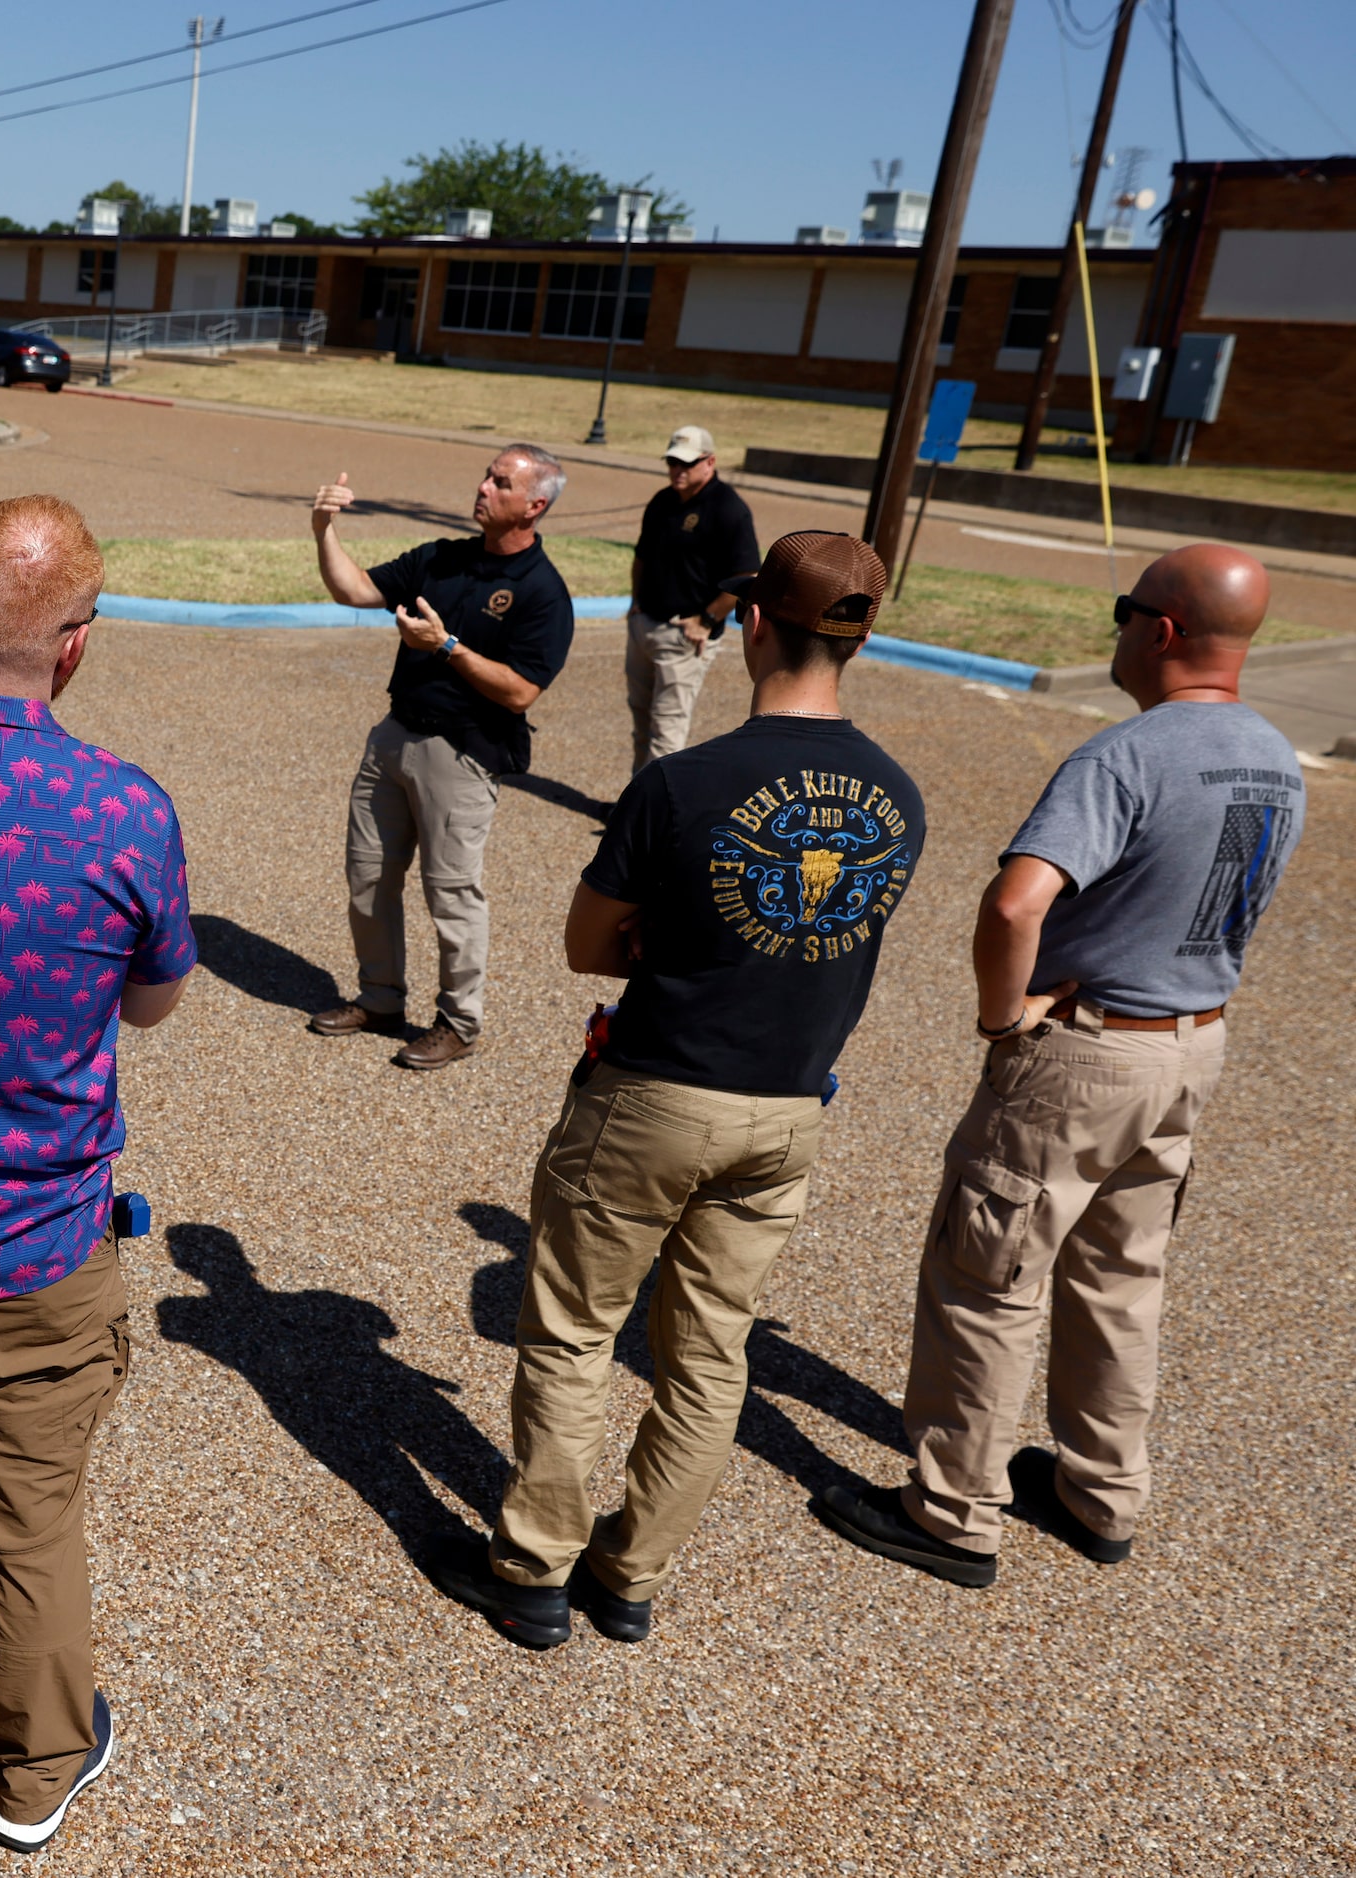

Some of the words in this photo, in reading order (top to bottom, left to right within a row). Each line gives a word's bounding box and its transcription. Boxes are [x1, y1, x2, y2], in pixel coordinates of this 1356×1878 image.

[729, 786, 781, 833] BEN
[774, 776, 799, 802] E.
[799, 769, 863, 802] KEITH
[862, 784, 906, 837] FOOD
[807, 806, 843, 828] AND
[709, 858, 796, 959] EQUIPMENT
[802, 919, 872, 964] SHOW
